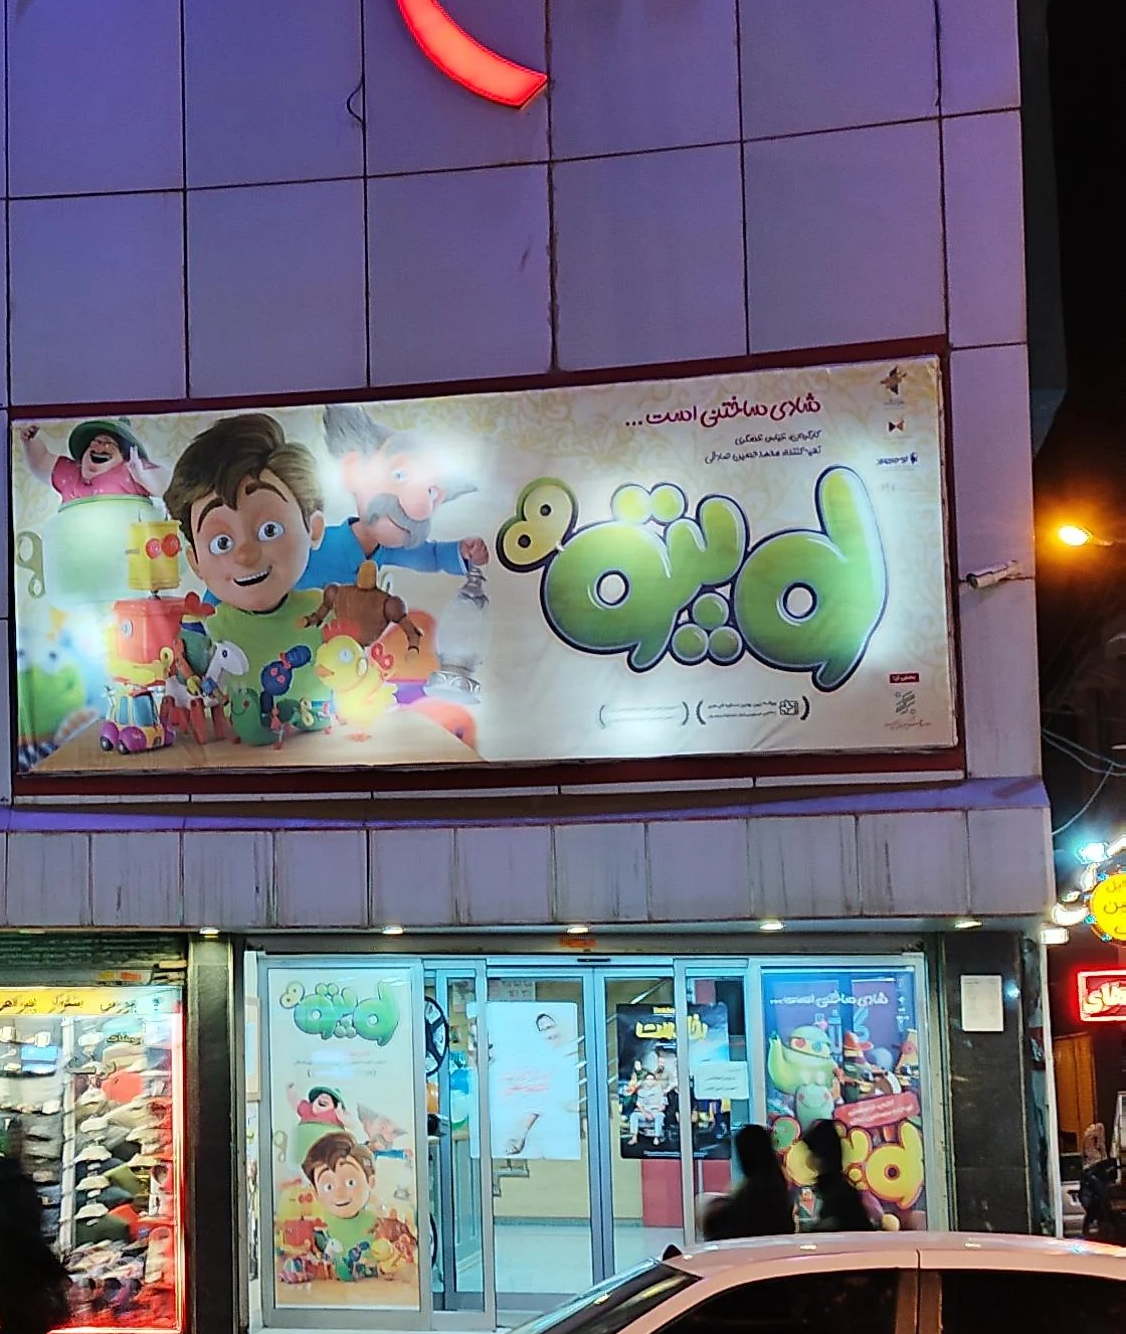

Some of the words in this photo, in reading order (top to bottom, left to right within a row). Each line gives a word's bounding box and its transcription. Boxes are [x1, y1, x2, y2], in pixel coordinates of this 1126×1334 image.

[700, 395, 768, 428] ساختنی
[770, 392, 821, 421] شادی
[536, 463, 889, 694] لوپتو
